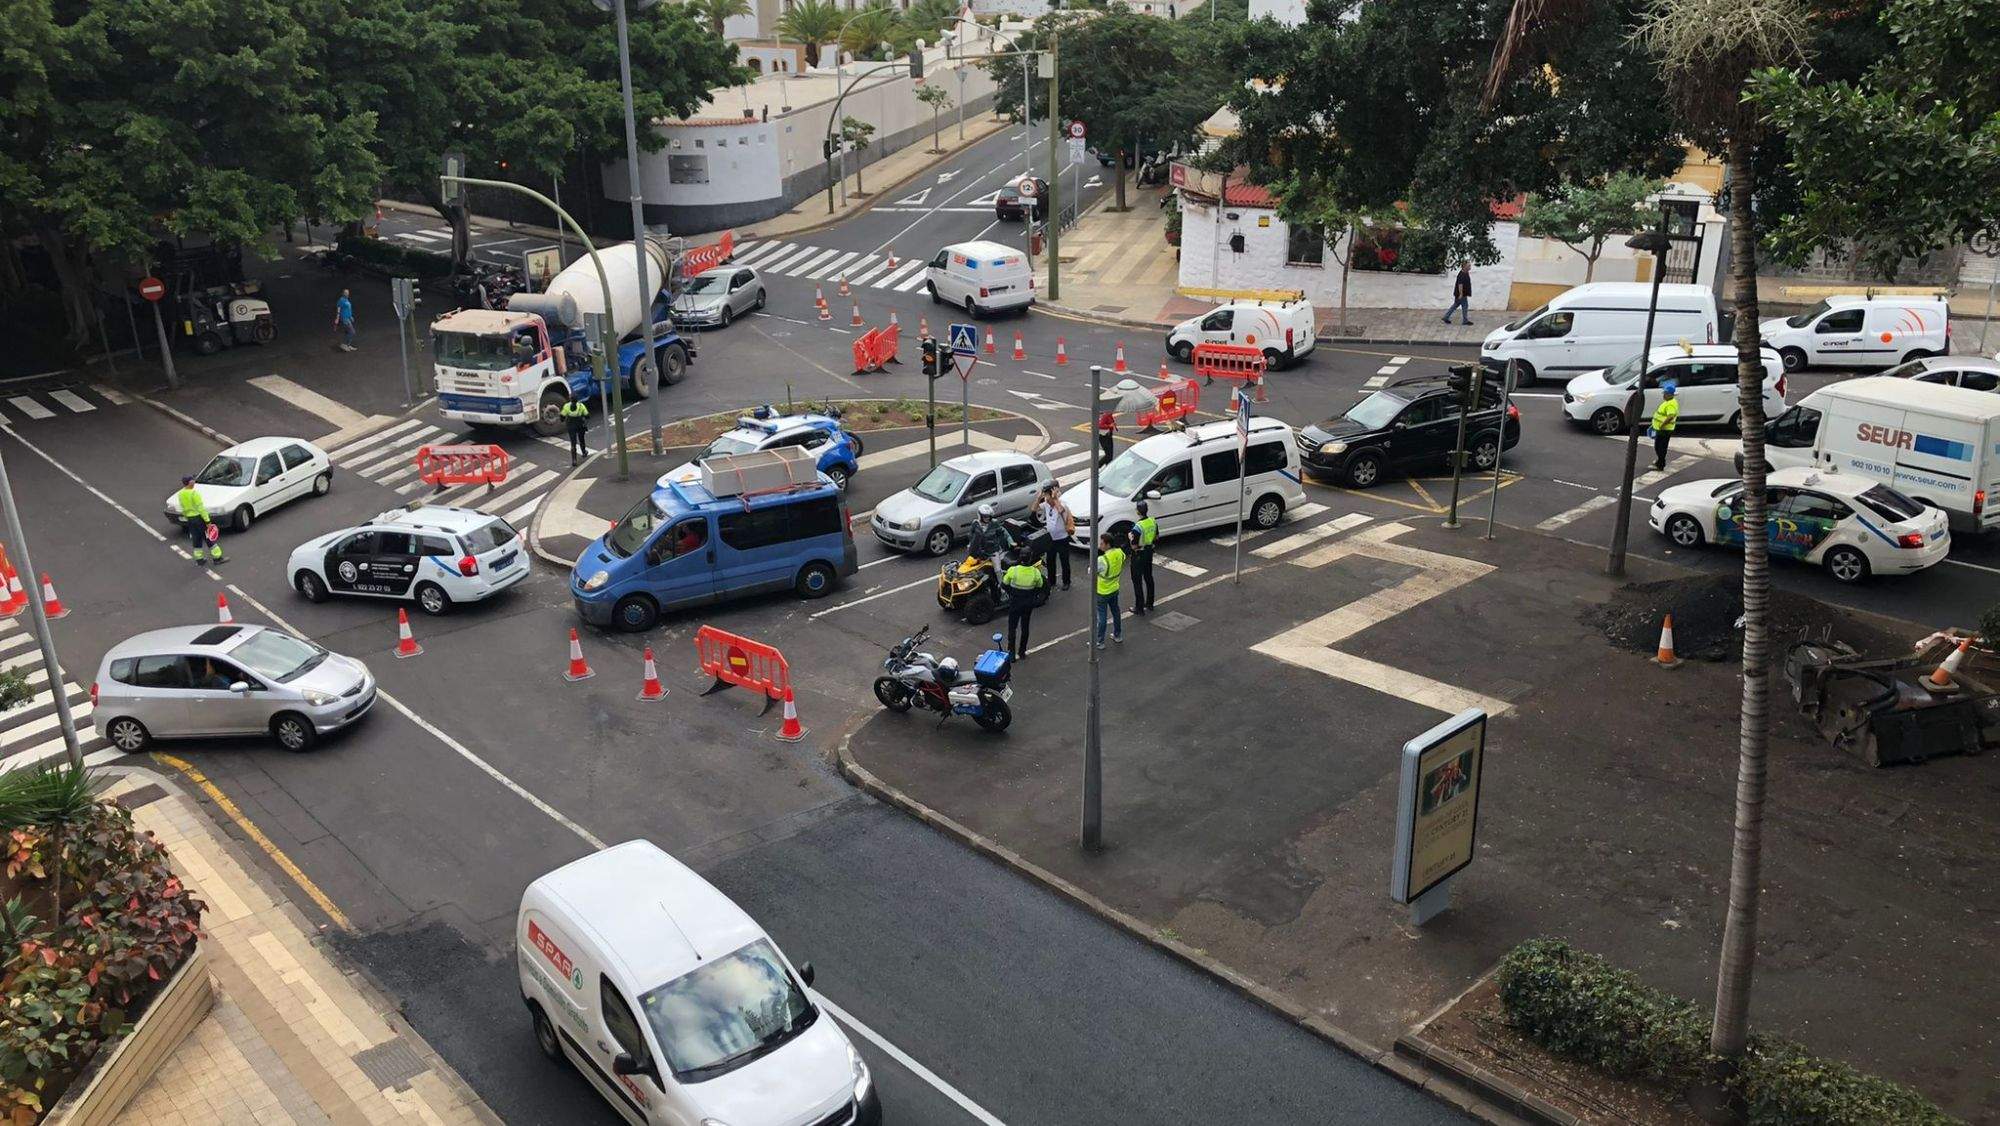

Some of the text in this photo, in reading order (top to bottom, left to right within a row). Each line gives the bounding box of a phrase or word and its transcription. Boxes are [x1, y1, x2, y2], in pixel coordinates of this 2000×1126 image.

[1072, 126, 1083, 134] 30
[1856, 422, 1914, 451] SEUR
[1895, 471, 1957, 490] www.seur.com
[535, 932, 573, 981] SPAR
